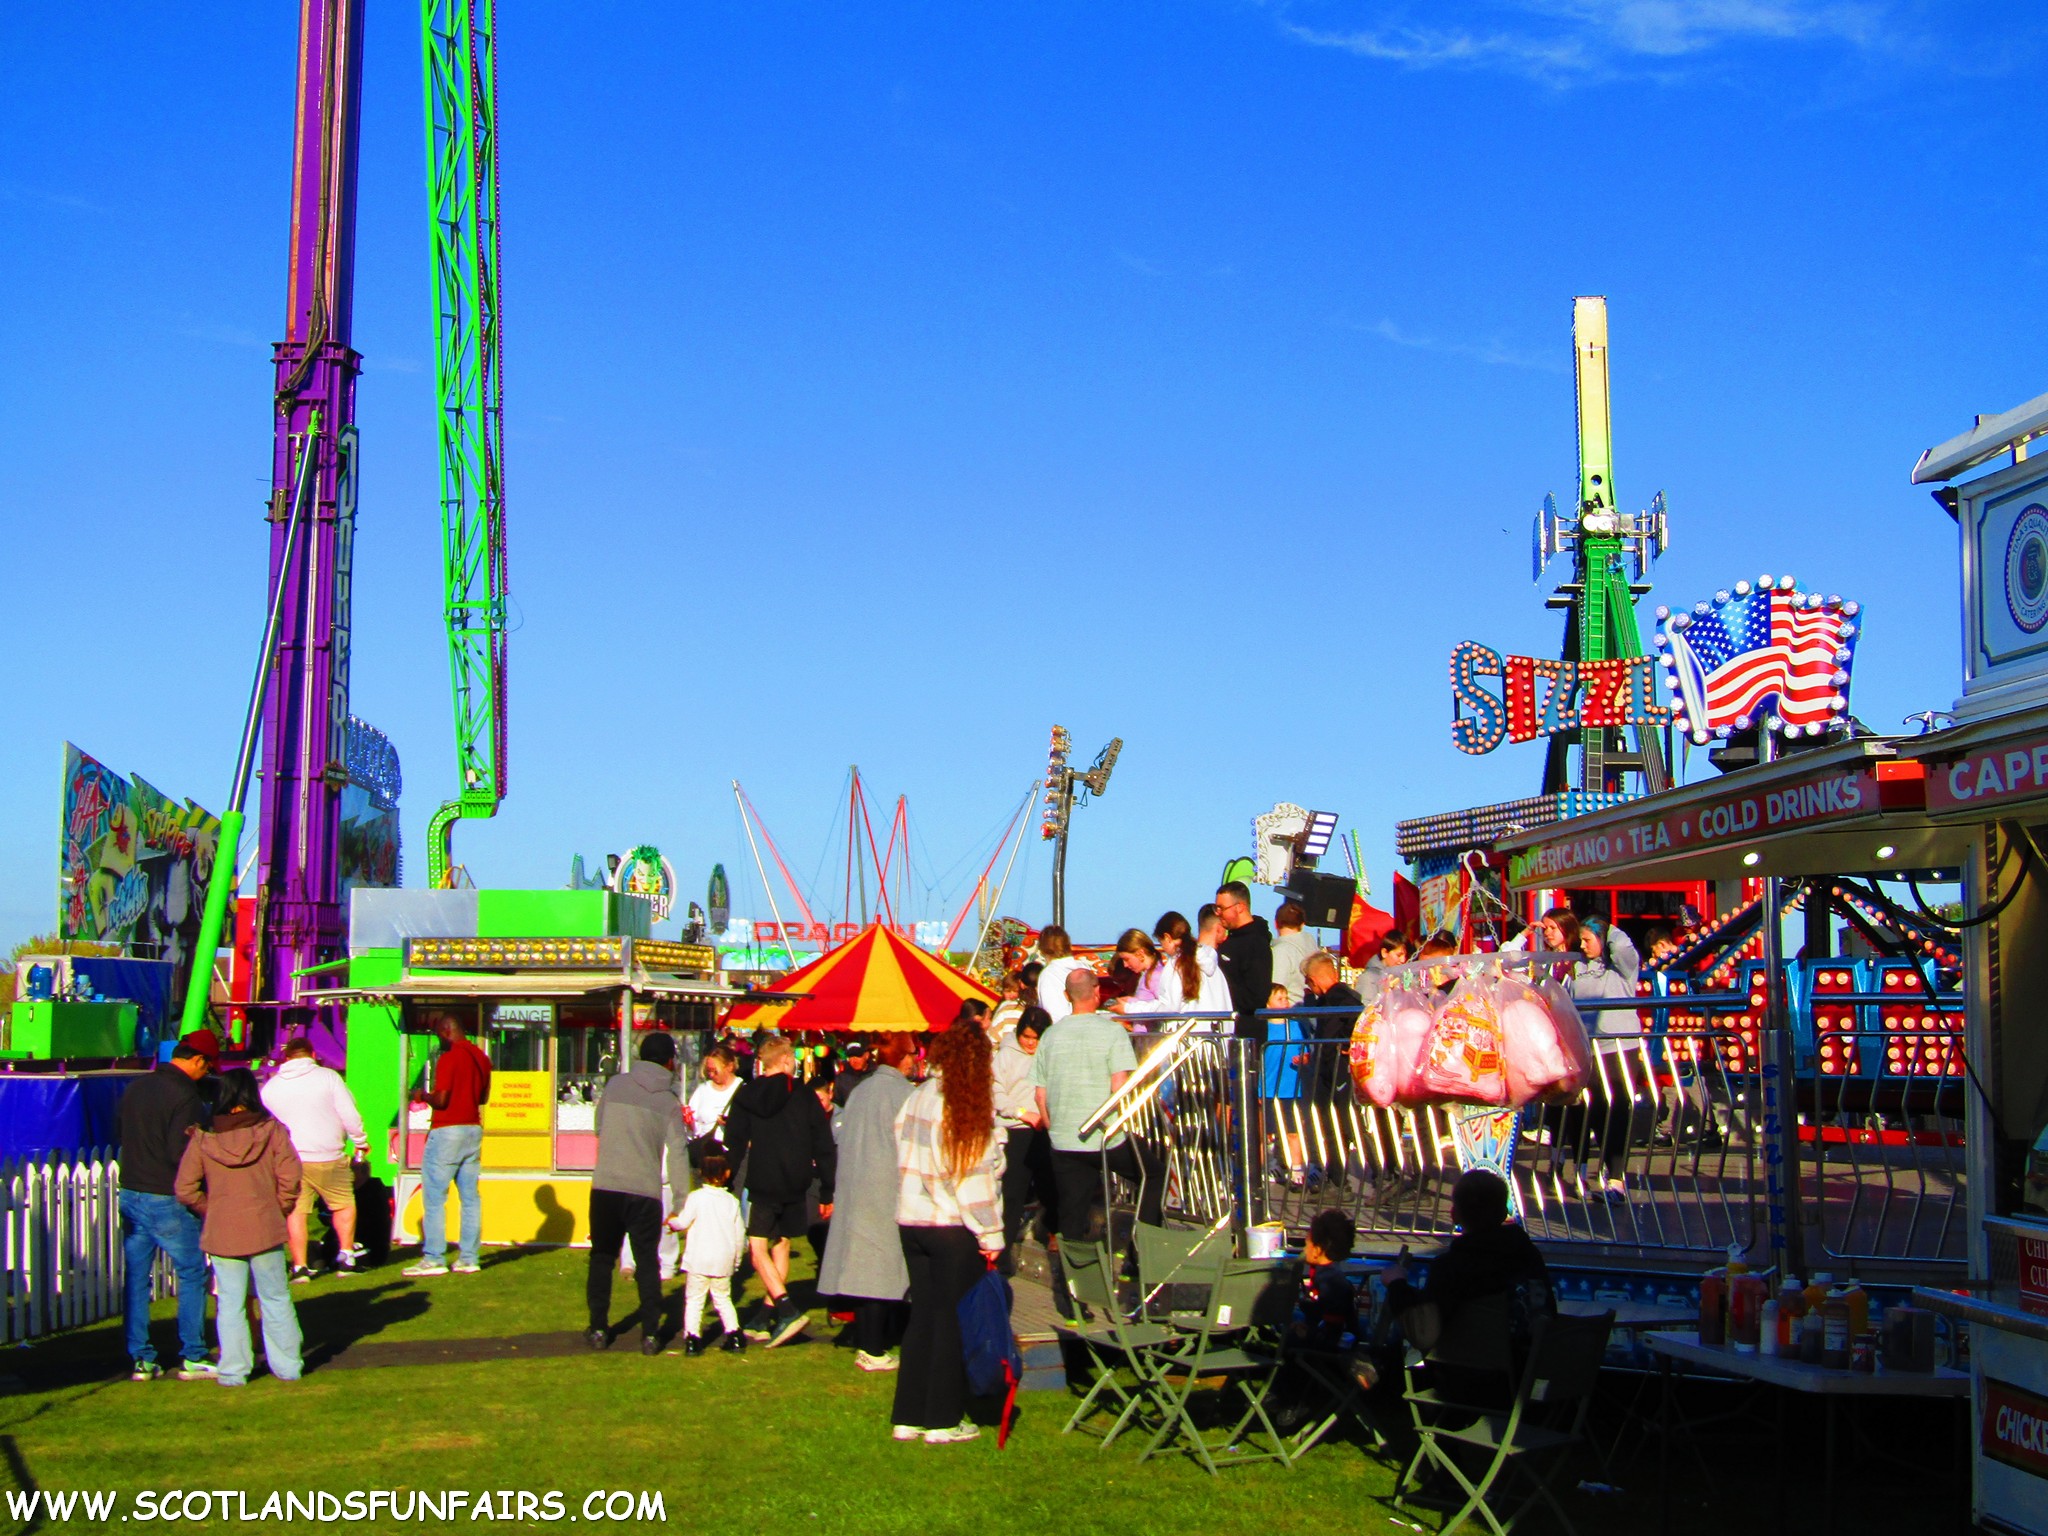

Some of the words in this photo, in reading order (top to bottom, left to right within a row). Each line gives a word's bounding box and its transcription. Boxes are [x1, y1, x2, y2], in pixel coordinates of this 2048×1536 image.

[1517, 836, 1610, 880] AMERICANO
[1629, 821, 1671, 854] TEA
[1699, 800, 1758, 839] COLD
[1766, 774, 1861, 826] DRINKS
[753, 922, 917, 943] DRAGN
[494, 1010, 551, 1021] HANGE
[2025, 1238, 2048, 1261] CHI
